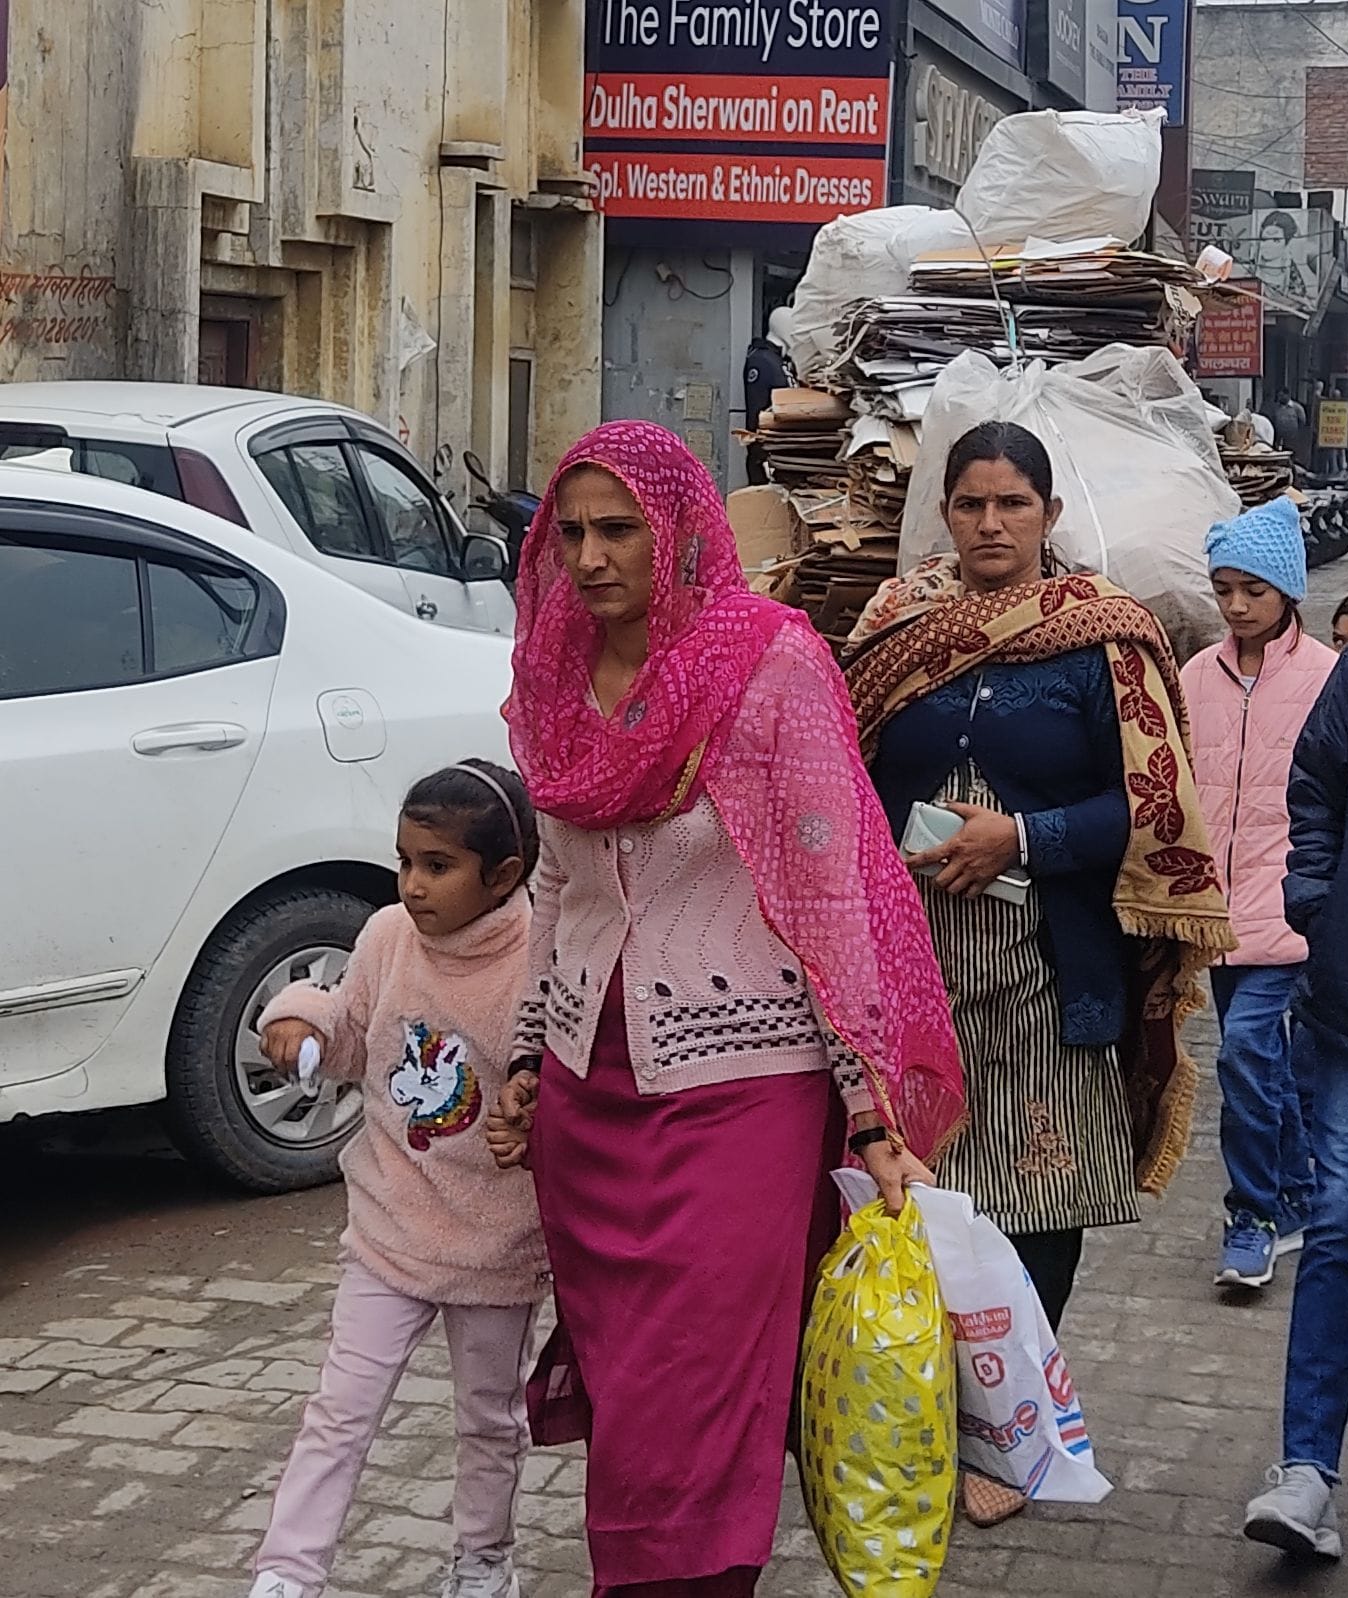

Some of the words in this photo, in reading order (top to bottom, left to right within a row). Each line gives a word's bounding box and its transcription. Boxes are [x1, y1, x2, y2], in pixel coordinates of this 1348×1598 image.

[604, 0, 659, 45] The
[669, 0, 780, 62] Family
[786, 0, 880, 49] Store
[590, 82, 658, 129] Dulha
[661, 83, 778, 133] Sherwani
[782, 98, 813, 133] on
[818, 88, 879, 135] Rent
[1117, 84, 1173, 98] AMILY
[589, 162, 622, 207] Spl.
[626, 163, 707, 201] Western
[711, 165, 725, 201] &
[729, 165, 791, 205] Ethnic
[795, 167, 872, 207] Dresses
